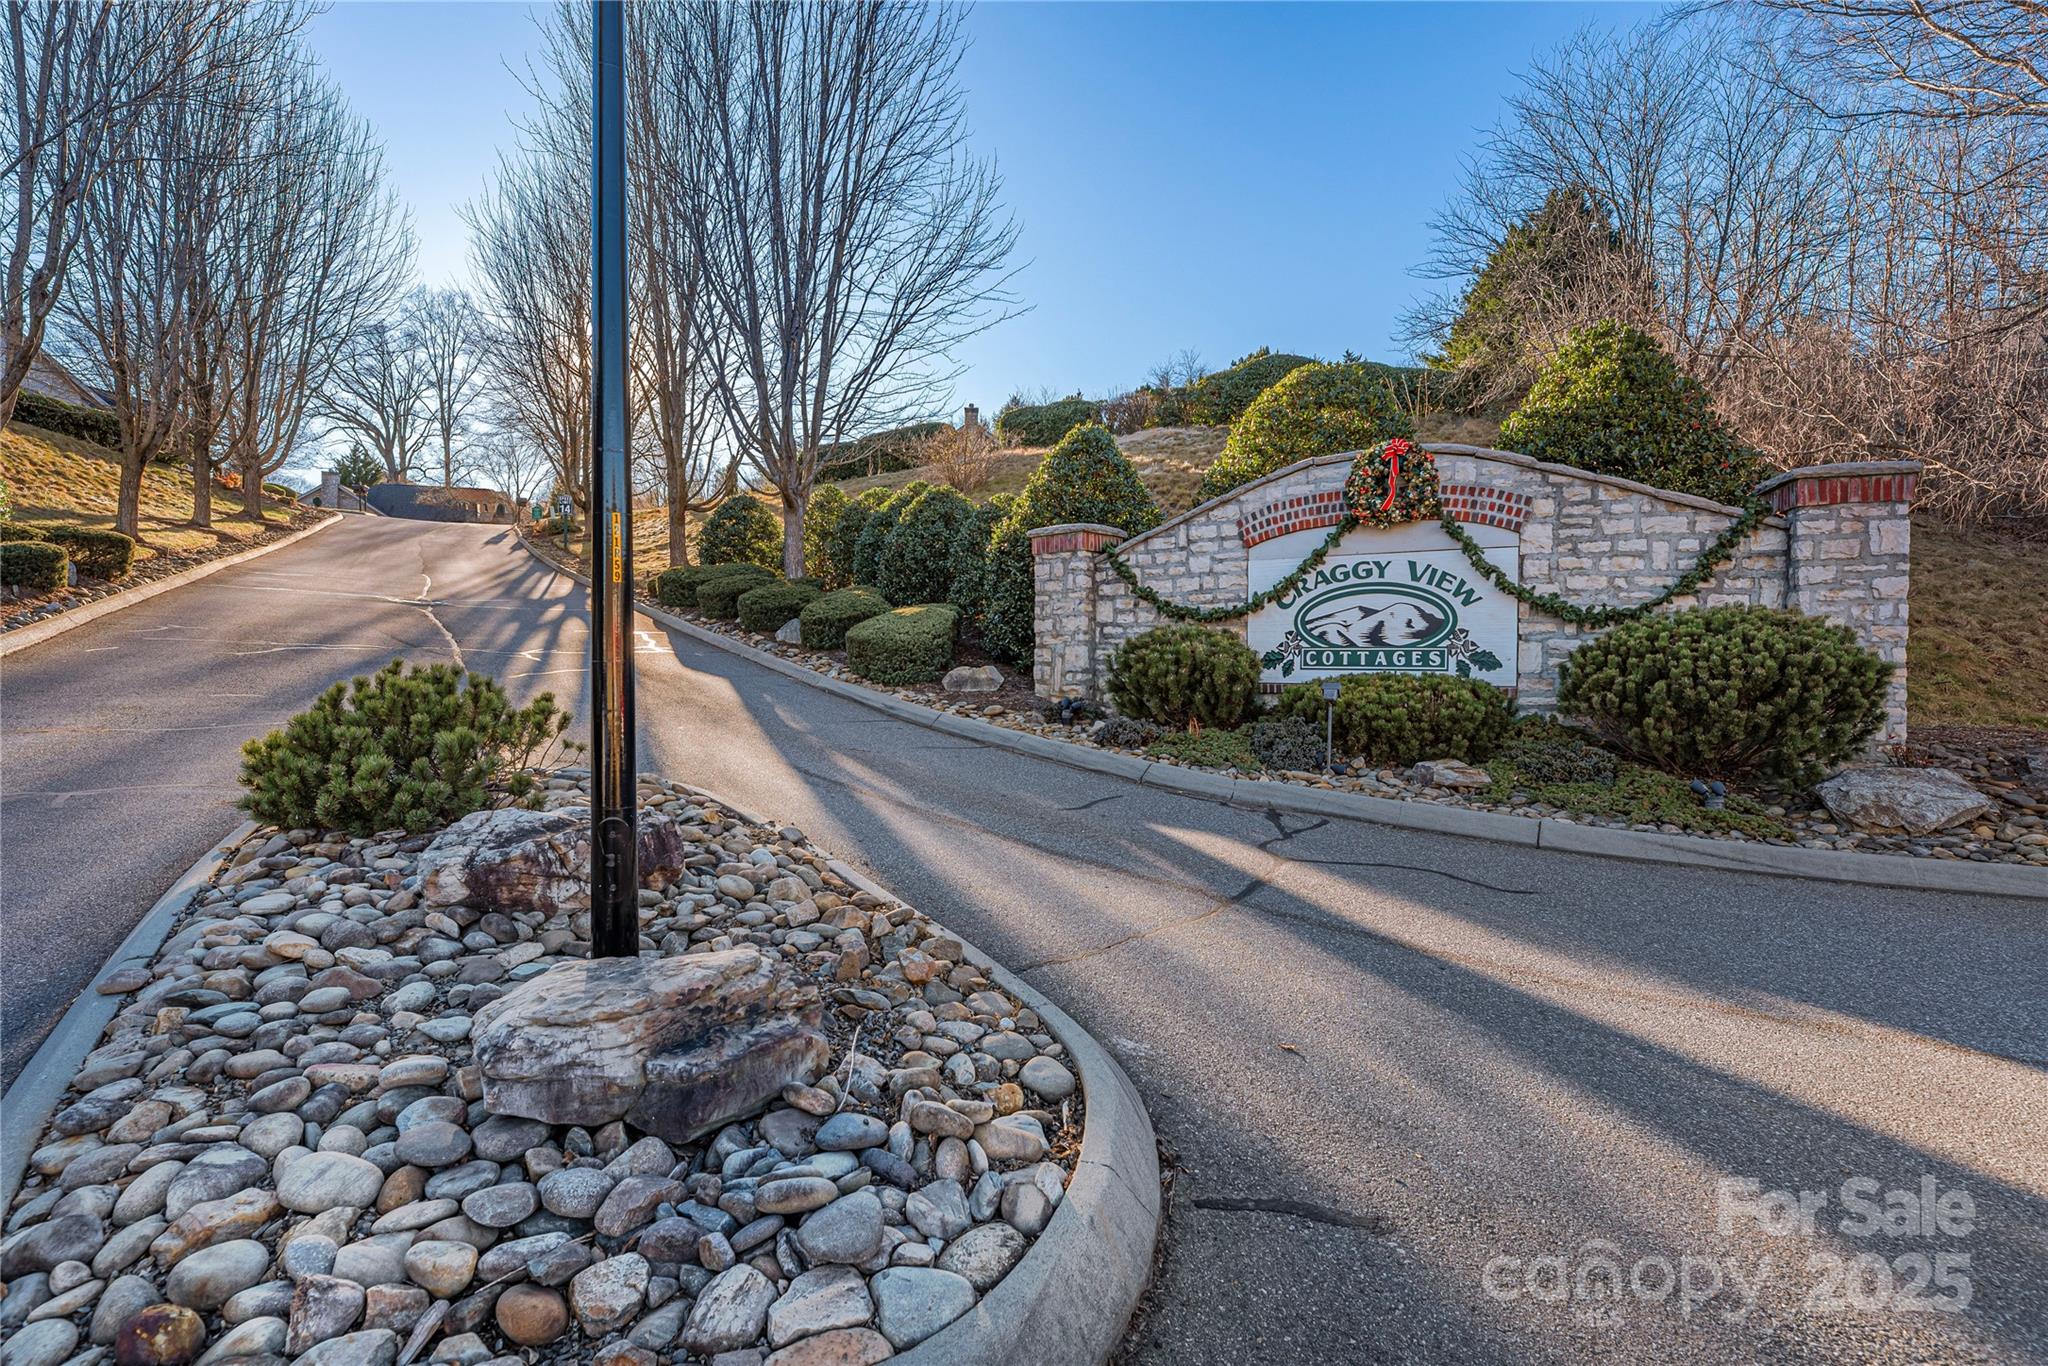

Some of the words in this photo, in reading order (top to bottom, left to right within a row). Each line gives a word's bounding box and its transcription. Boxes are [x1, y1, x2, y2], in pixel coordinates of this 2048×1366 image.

[560, 504, 571, 513] 14
[1407, 560, 1483, 608] VIEW
[1306, 650, 1442, 666] COTTAGES
